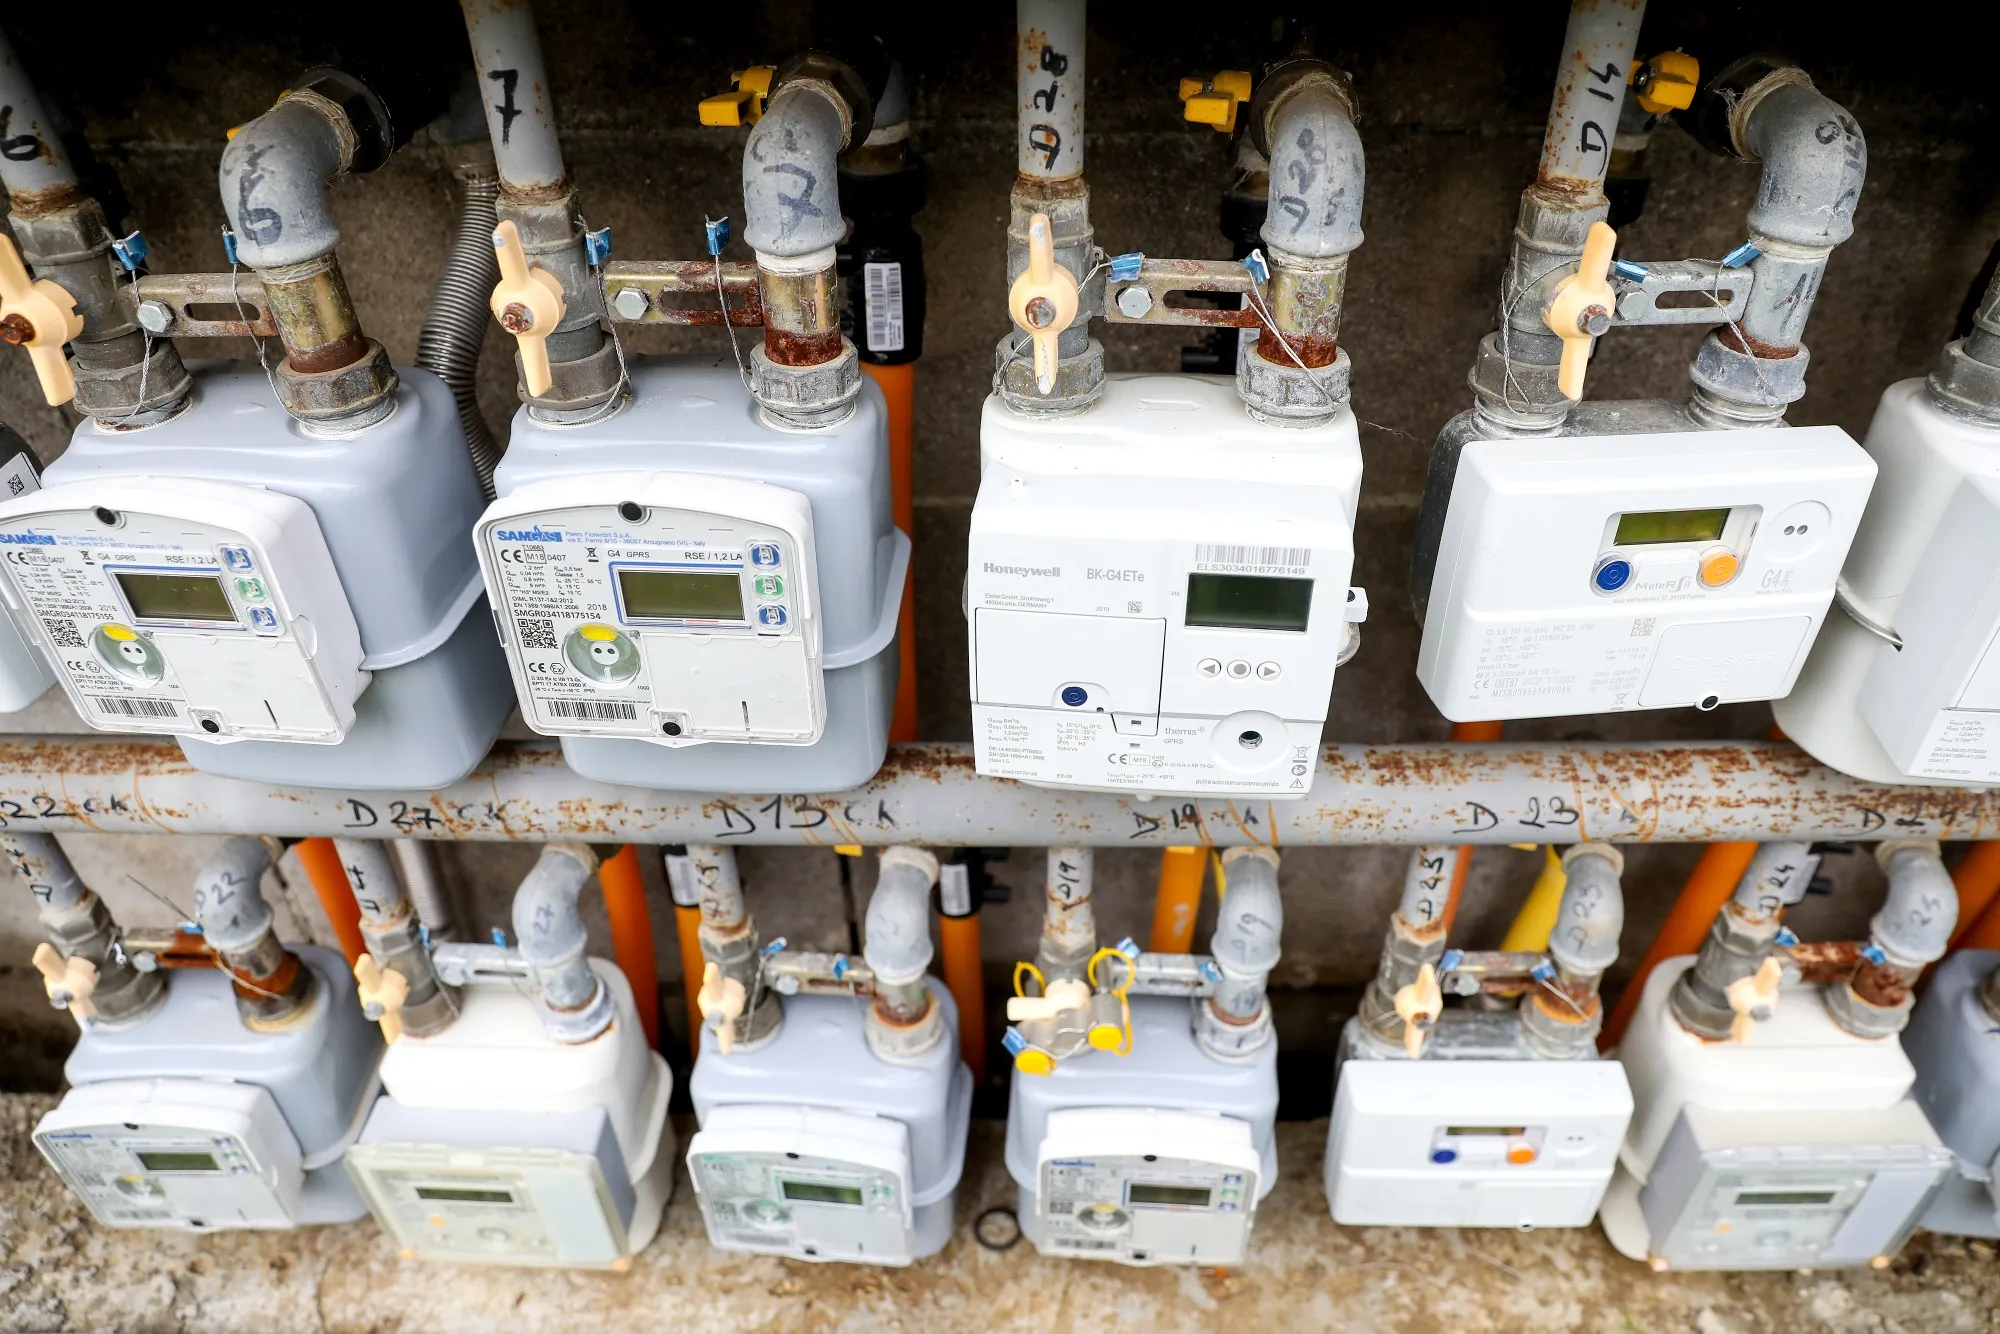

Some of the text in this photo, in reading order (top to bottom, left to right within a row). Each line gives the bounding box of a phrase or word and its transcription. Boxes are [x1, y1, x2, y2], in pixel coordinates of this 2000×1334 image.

[487, 69, 522, 149] 7
[497, 526, 562, 542] SAMGAS
[98, 552, 110, 560] G4
[166, 556, 184, 564] RSE
[714, 553, 728, 562] 1,2
[730, 553, 743, 561] LA
[984, 562, 1060, 578] Honeywell
[1197, 564, 1305, 574] ELS3034016776149
[1762, 569, 1781, 588] G4
[514, 610, 601, 619] SMGR034118175154
